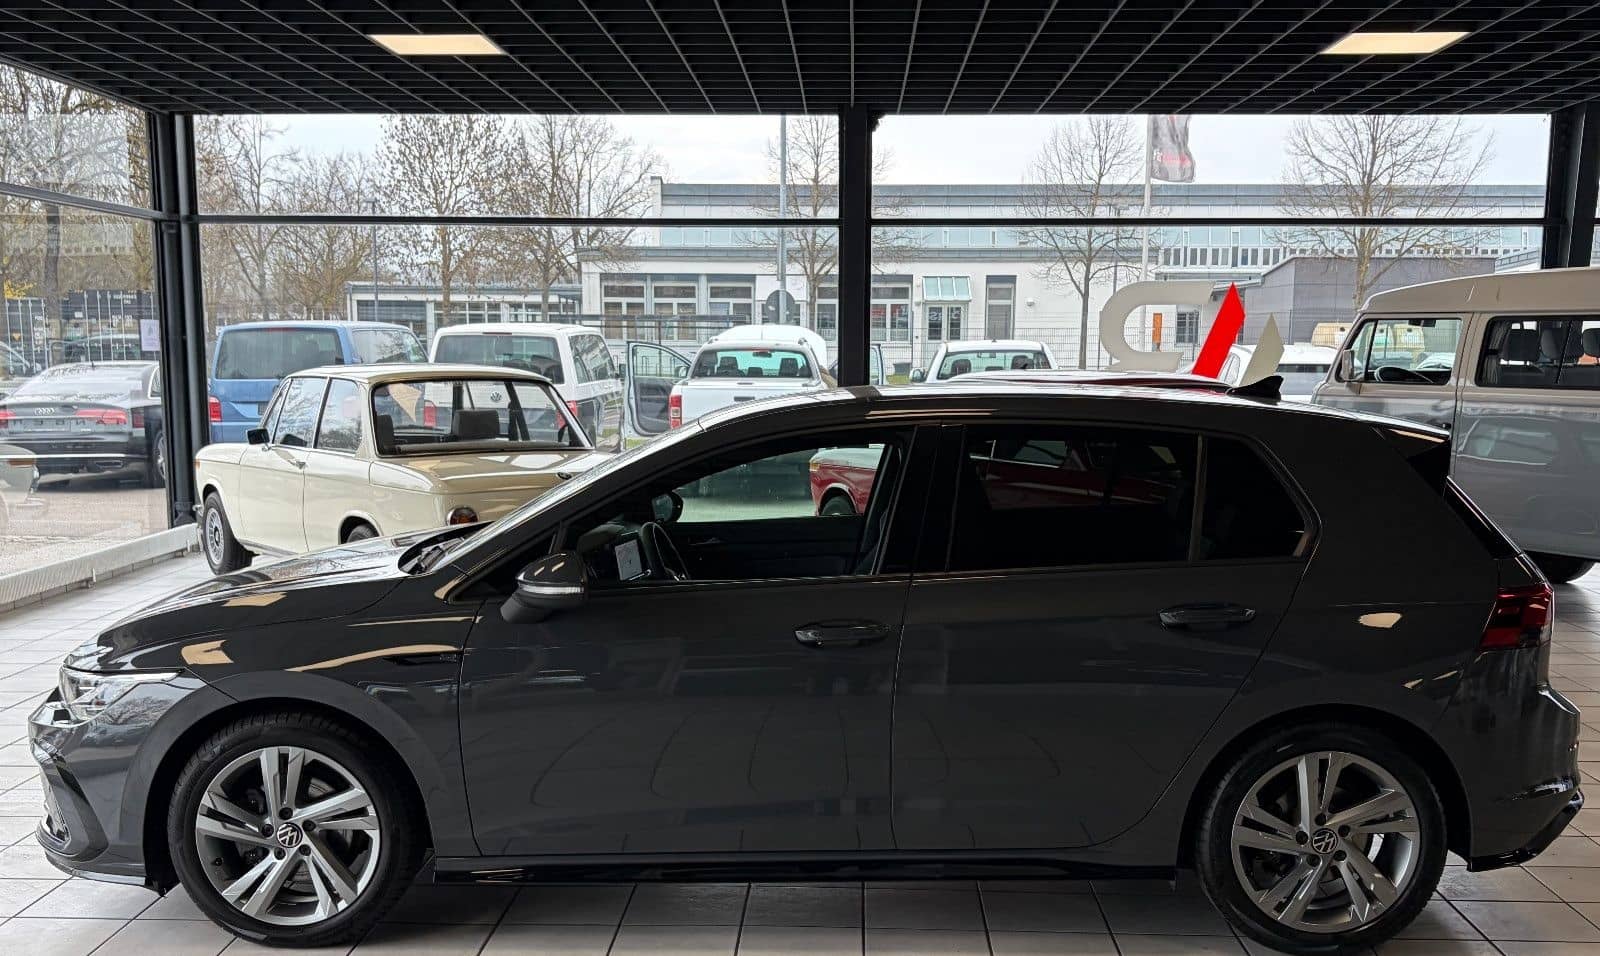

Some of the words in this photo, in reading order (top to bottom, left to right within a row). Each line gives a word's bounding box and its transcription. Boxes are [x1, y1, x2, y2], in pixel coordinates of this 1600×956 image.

[490, 391, 503, 402] VW
[277, 822, 303, 848] VW
[1312, 828, 1338, 854] VW
